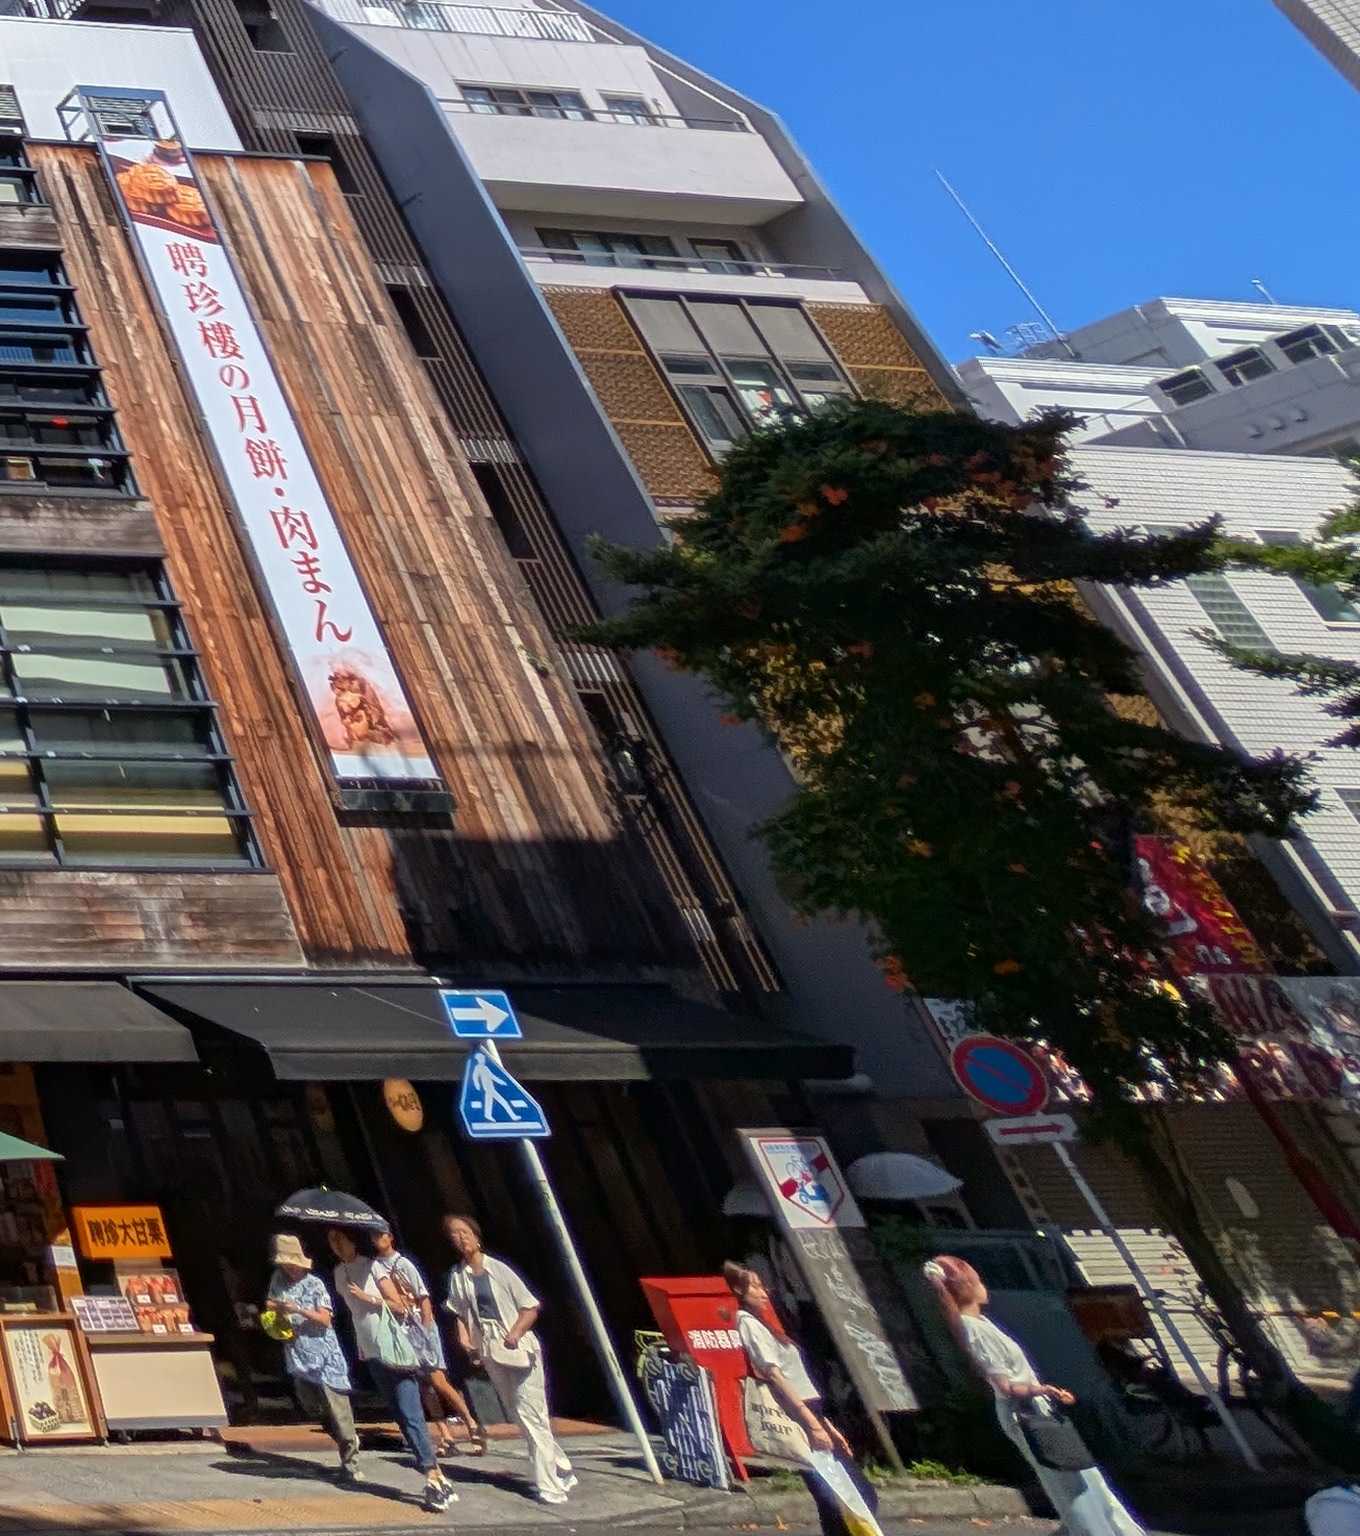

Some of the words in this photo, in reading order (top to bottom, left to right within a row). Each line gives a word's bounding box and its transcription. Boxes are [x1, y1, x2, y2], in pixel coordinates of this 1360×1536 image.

[166, 240, 353, 645] 聘珍樓の月餅・肉まん
